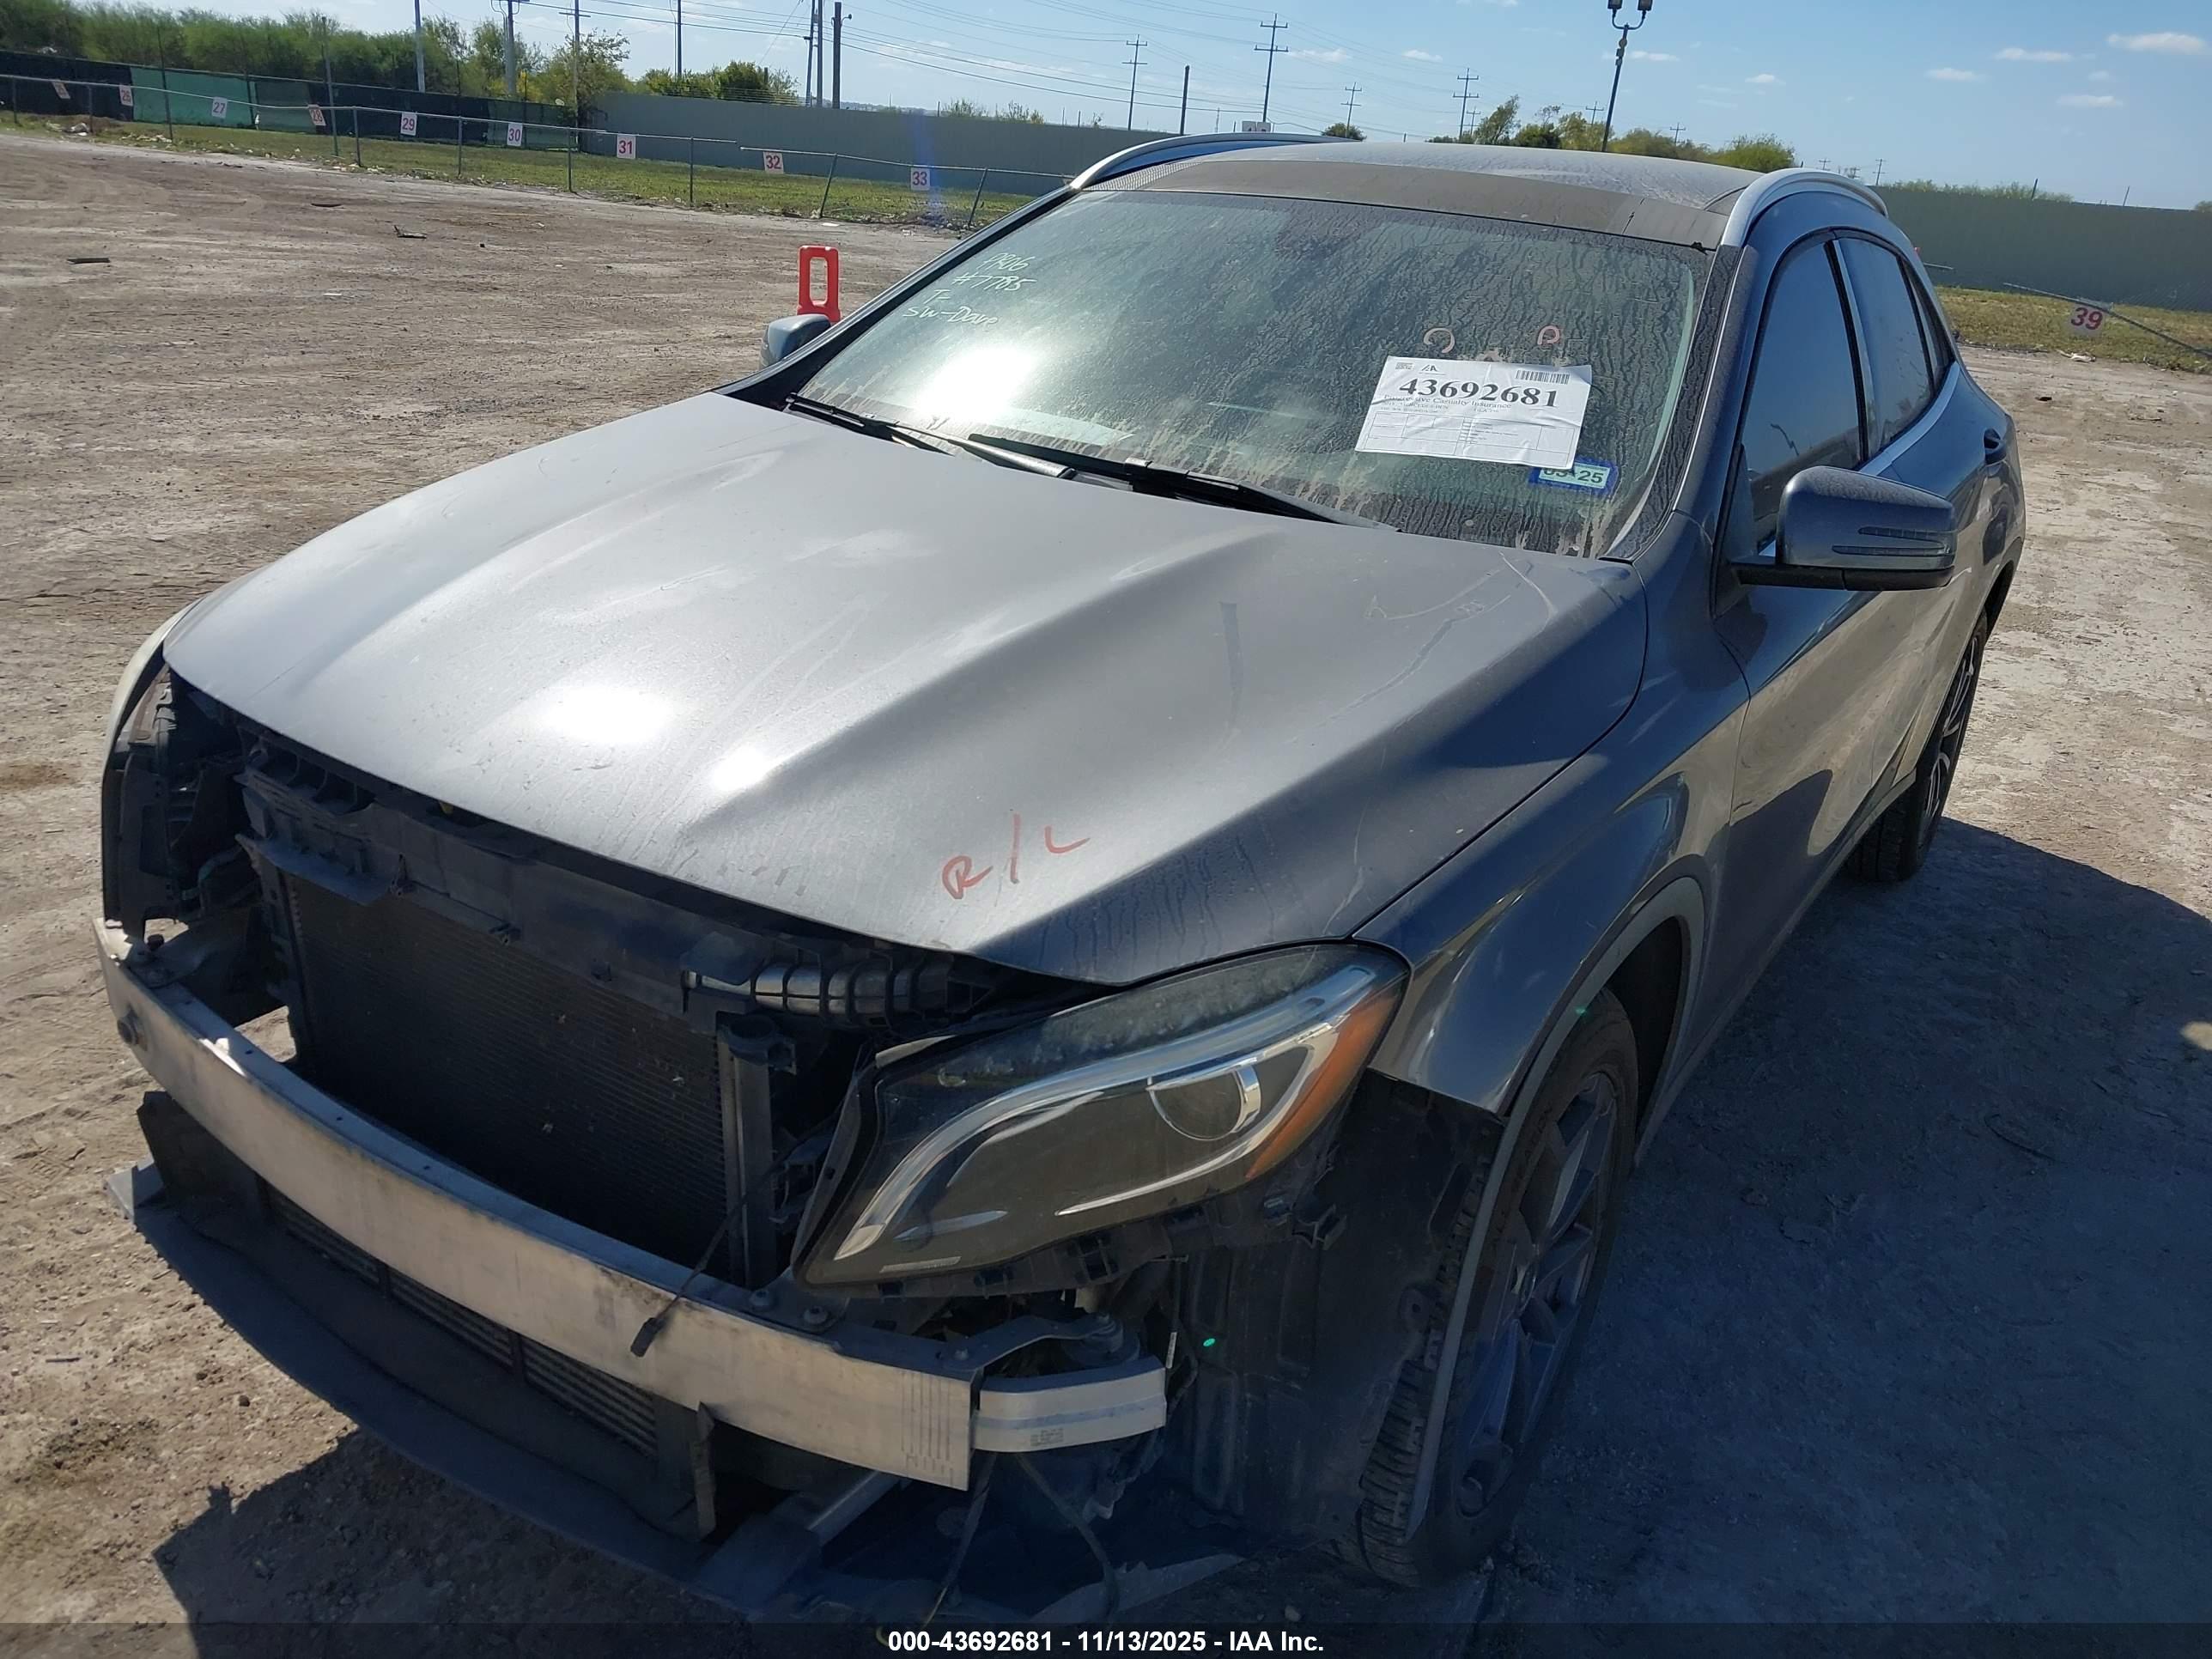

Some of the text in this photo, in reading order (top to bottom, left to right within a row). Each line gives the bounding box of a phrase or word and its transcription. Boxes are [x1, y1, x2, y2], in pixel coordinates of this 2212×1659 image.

[213, 101, 226, 113] 27
[403, 117, 415, 131] 29
[508, 128, 520, 142] 30
[618, 140, 633, 155] 31
[766, 155, 782, 169] 32
[913, 171, 927, 185] 33
[951, 271, 1037, 291] #7785
[2070, 307, 2103, 331] 39
[1399, 378, 1559, 408] 43692681
[1472, 400, 1512, 409] Insurance
[1577, 470, 1603, 483] 25
